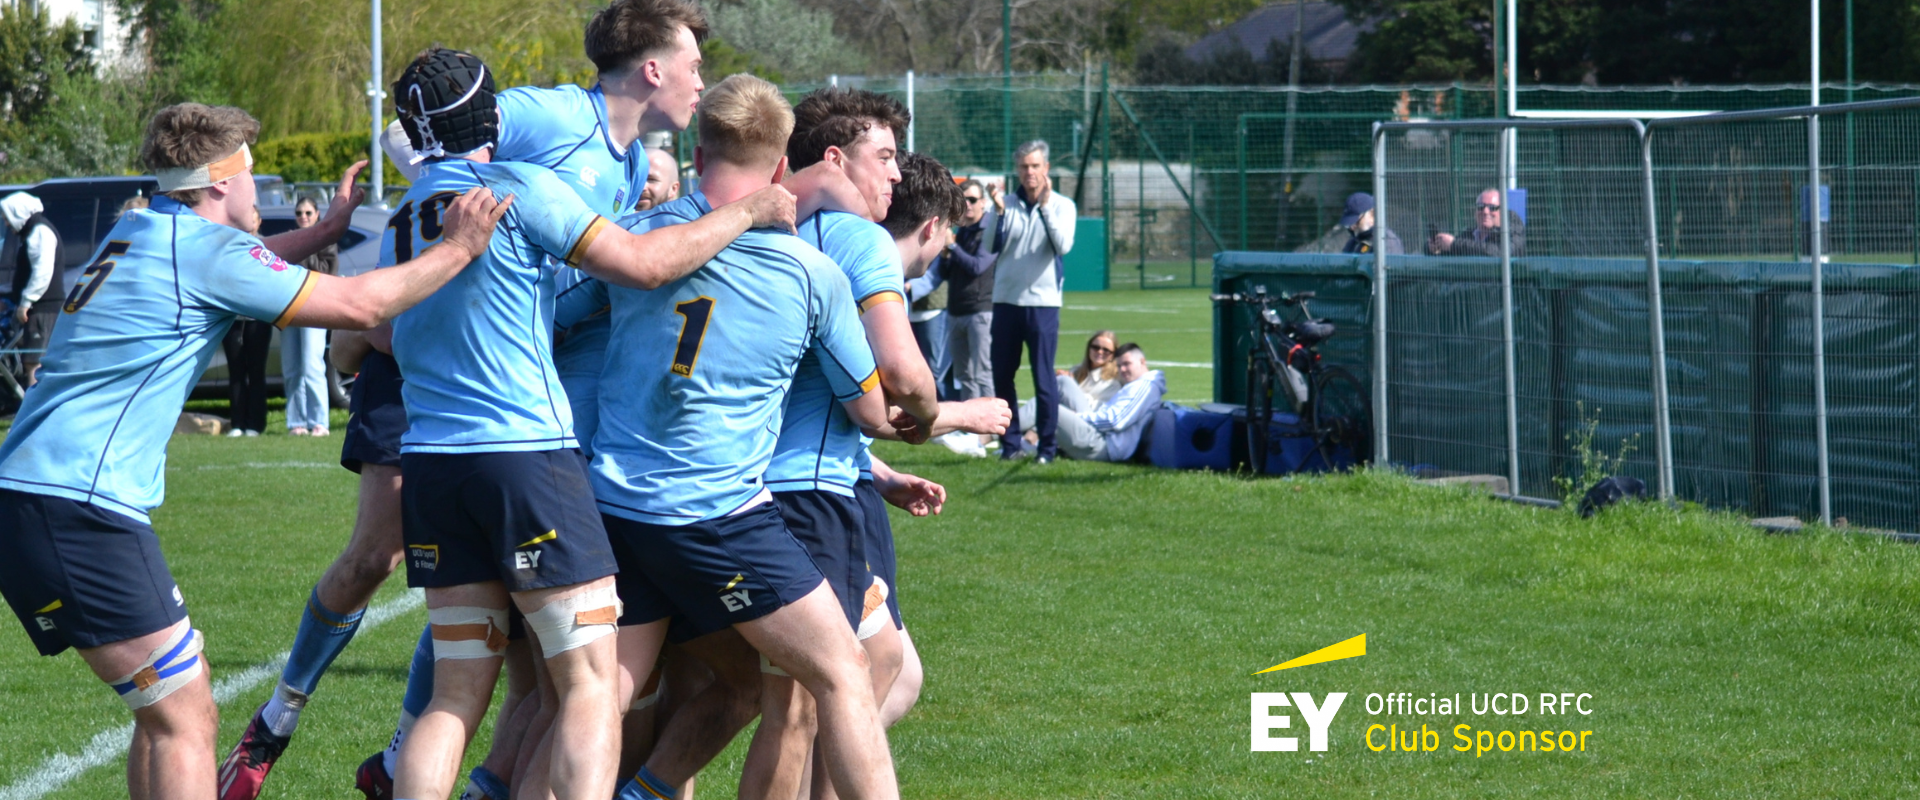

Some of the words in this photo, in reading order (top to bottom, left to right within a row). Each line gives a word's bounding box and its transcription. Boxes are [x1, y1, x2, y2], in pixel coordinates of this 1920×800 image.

[387, 190, 464, 266] 19
[63, 240, 133, 315] 5
[671, 295, 717, 379] 1
[515, 550, 542, 570] EY
[720, 589, 753, 613] EY
